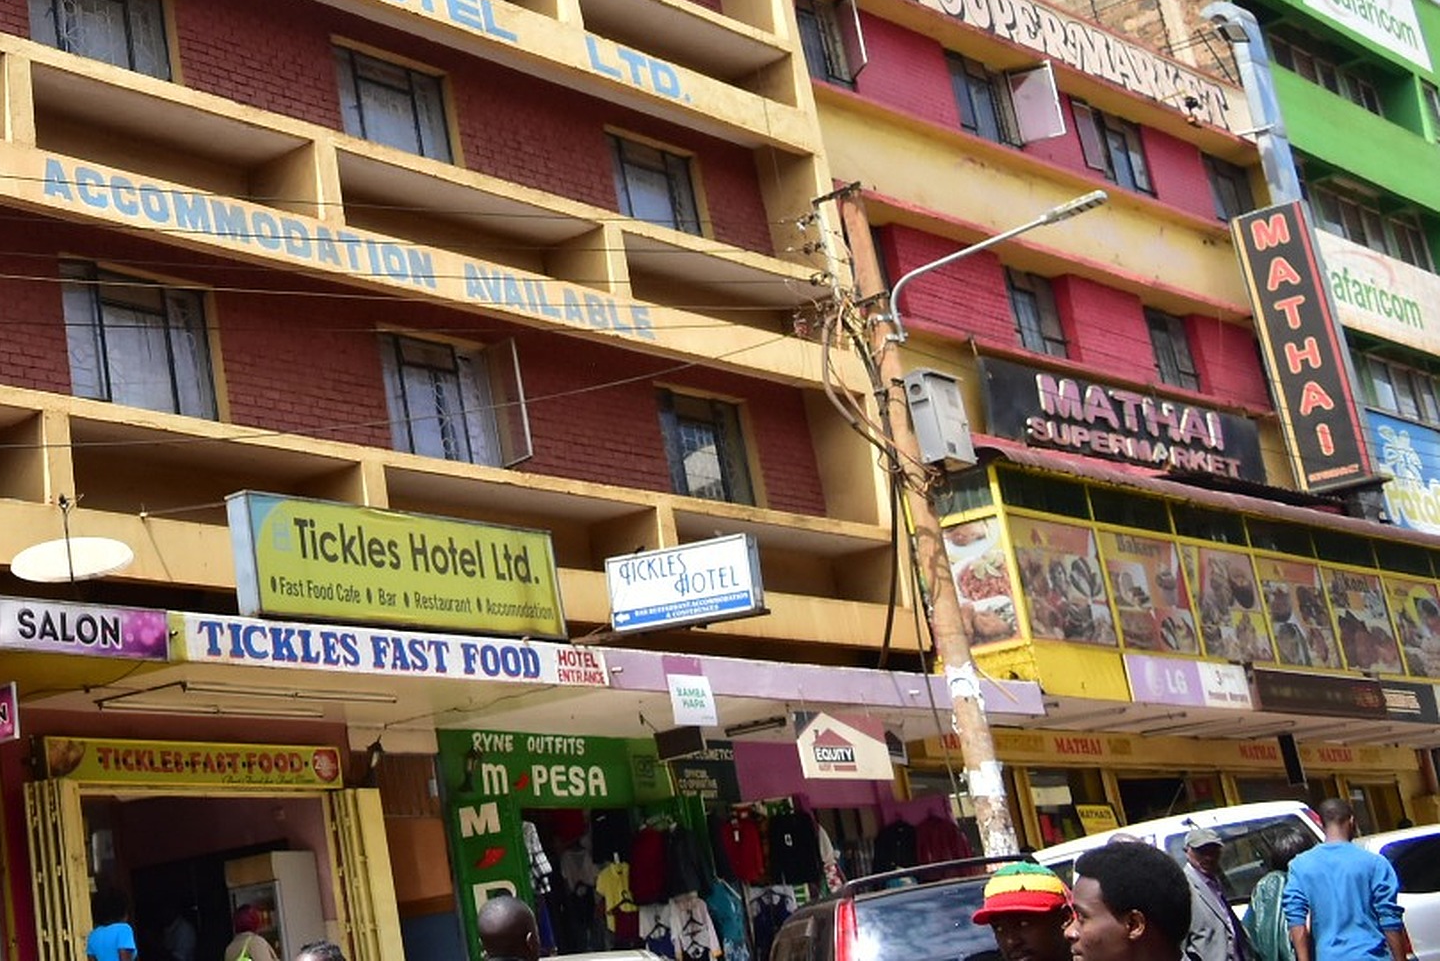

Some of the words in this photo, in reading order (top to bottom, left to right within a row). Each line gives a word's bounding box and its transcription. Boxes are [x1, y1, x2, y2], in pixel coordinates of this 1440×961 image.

[584, 35, 692, 103] LTD.
[43, 158, 438, 289] ACCOMMODATION
[464, 262, 656, 340] AVAILABLE
[1330, 266, 1424, 331] afaricom
[1249, 211, 1334, 457] MATHAI
[1035, 372, 1225, 451] MATHAI
[1026, 416, 1242, 480] SUPERMARKET
[293, 516, 401, 571] Tickles
[409, 533, 486, 580] Hotel
[491, 542, 540, 585] Ltd.
[619, 553, 688, 586] TICKLES
[673, 566, 740, 597] HOTEL
[279, 577, 305, 597] Fast
[307, 580, 335, 602] Food
[336, 583, 361, 604] Cafe
[378, 589, 398, 607] Bar
[414, 592, 472, 613] Restaurant
[17, 606, 123, 649] SALON
[197, 620, 361, 667] TICKLES
[370, 636, 450, 674] FAST
[460, 643, 541, 679] FOOD
[557, 649, 599, 668] HOTEL
[558, 668, 605, 685] ENTRANCE
[1165, 668, 1188, 695] LG
[96, 746, 184, 774] TICKLES
[190, 750, 242, 775] FAST
[247, 751, 304, 775] FOOD
[472, 732, 513, 754] RYNE
[527, 733, 585, 756] OUTFITS
[815, 747, 852, 762] EQUITY
[1054, 736, 1103, 755] MATHAI
[1239, 743, 1277, 761] MATHAI
[1317, 747, 1353, 763] MATHAI
[532, 763, 608, 797] PESA
[459, 802, 501, 838] M
